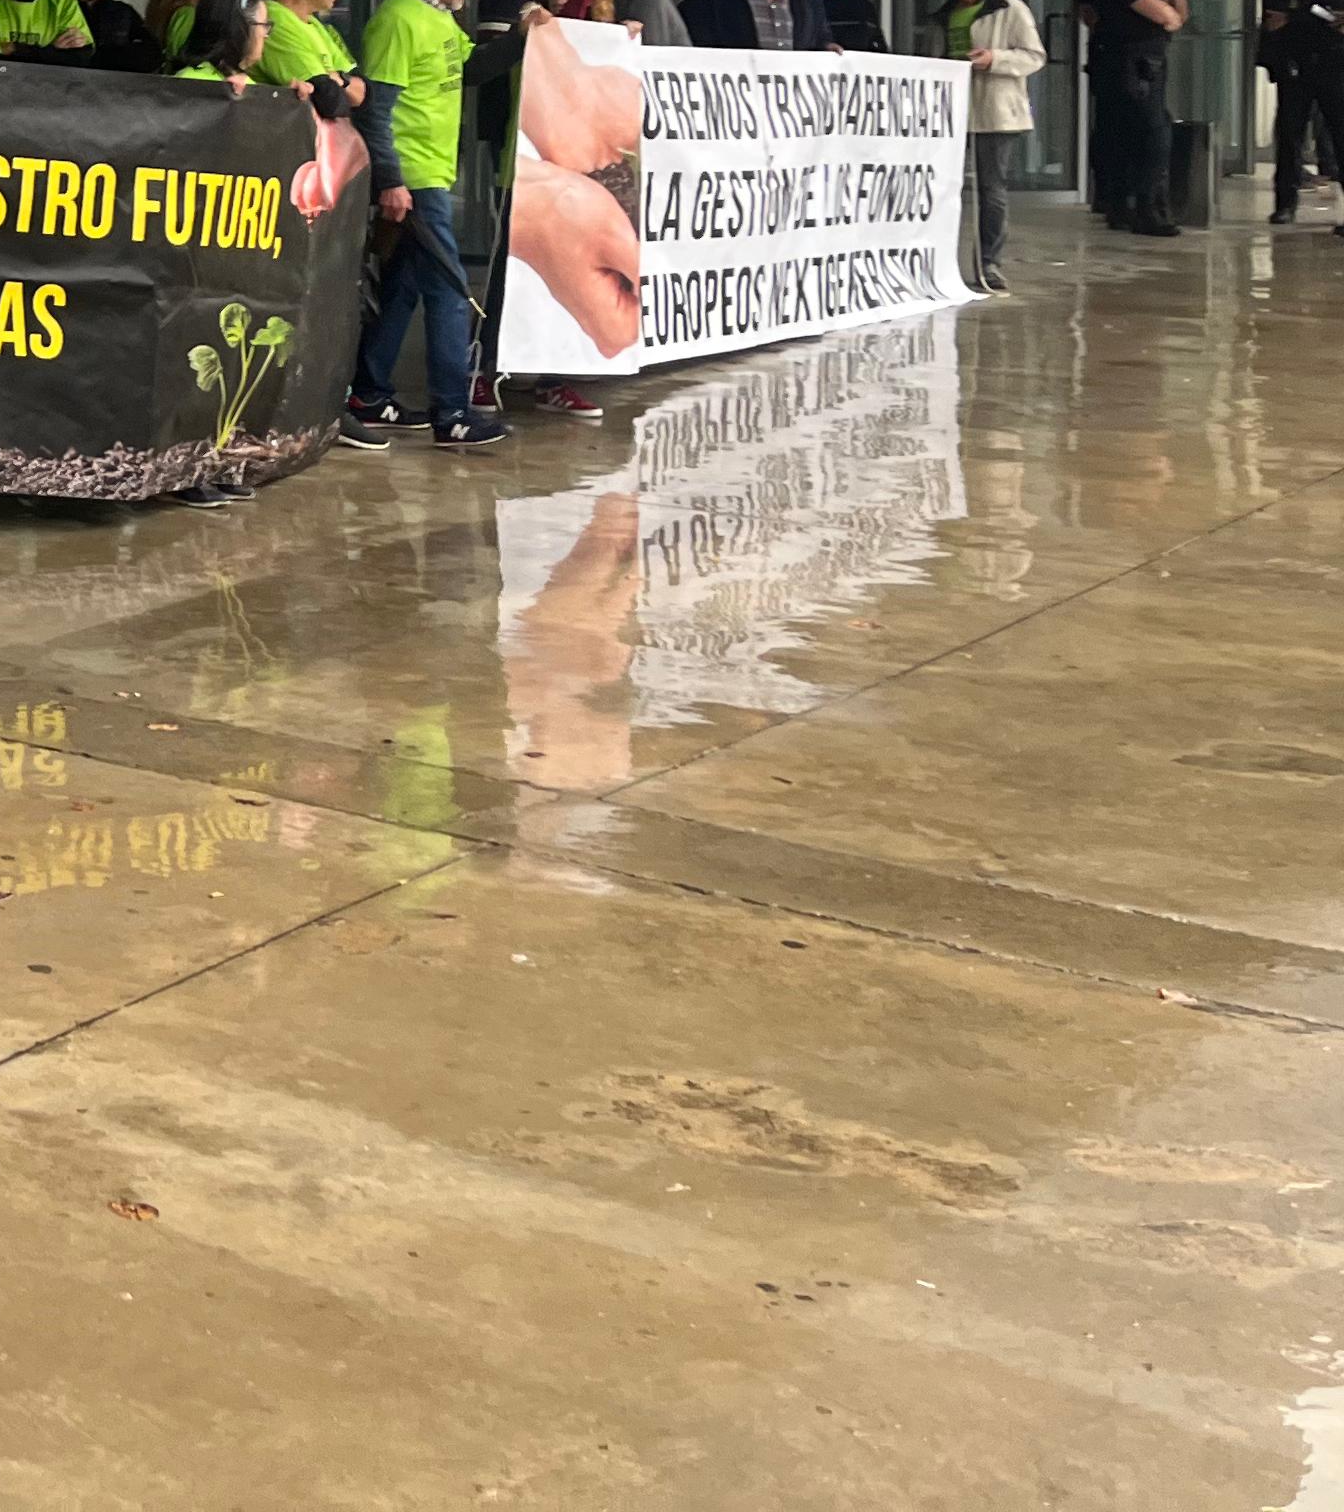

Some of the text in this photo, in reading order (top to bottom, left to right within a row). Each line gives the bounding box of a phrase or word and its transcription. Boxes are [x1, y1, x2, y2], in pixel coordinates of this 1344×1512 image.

[933, 80, 954, 139] EN
[131, 166, 283, 260] FUTURO,
[645, 171, 683, 243] LA
[854, 163, 935, 225] FONDOS
[639, 264, 765, 348] EUROPEOS
